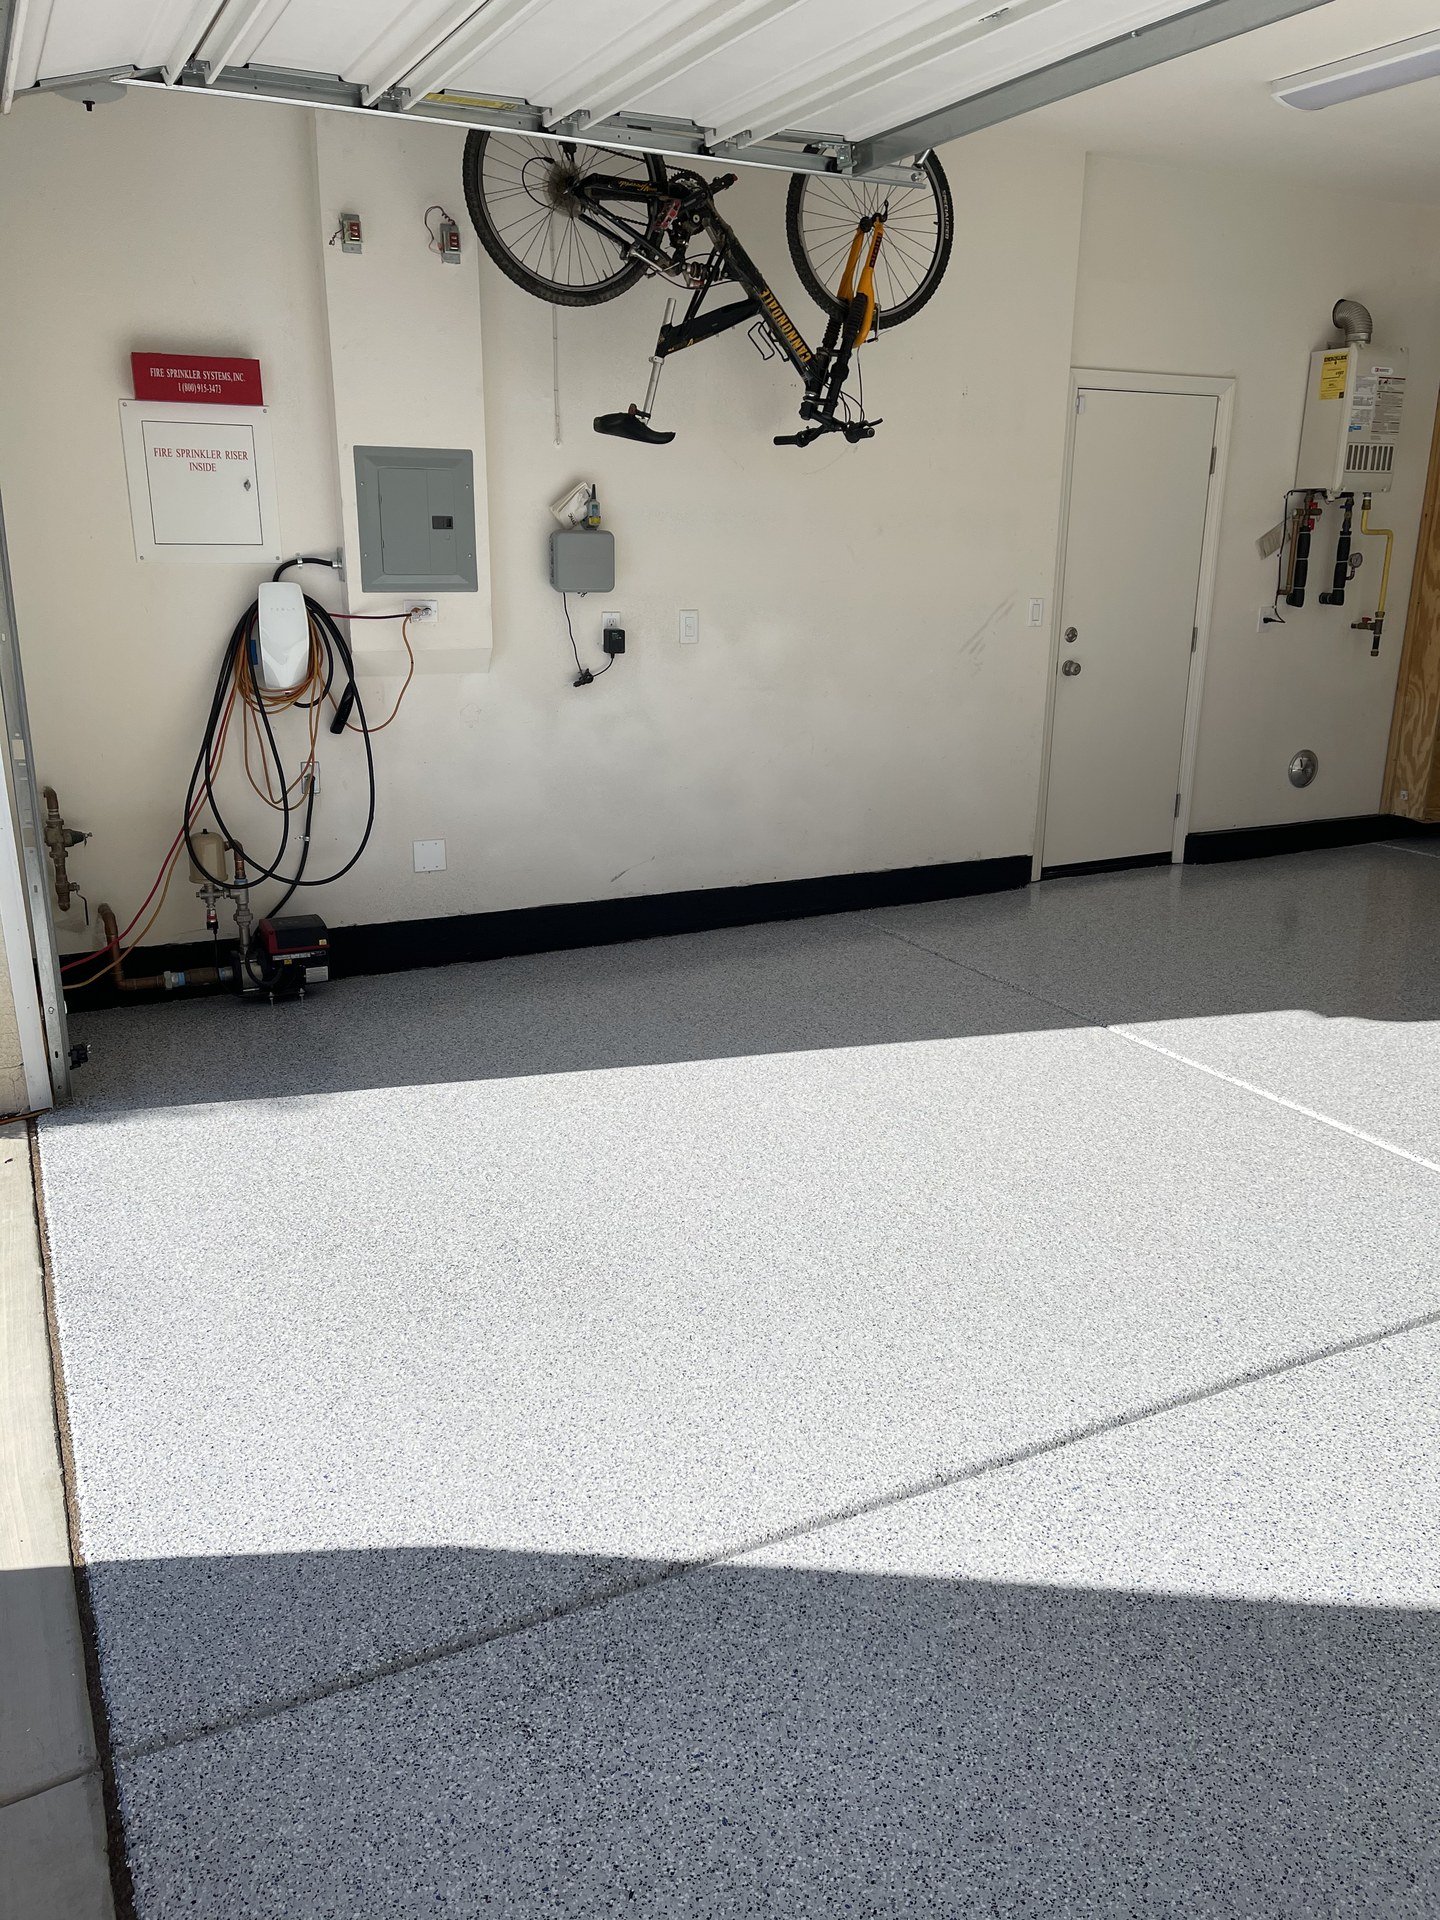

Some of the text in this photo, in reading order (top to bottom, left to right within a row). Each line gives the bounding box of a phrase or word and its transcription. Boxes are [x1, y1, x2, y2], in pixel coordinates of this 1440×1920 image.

[760, 289, 811, 362] CANNONDALE
[150, 367, 164, 378] FIRE
[166, 368, 201, 380] SPRINKLER
[154, 447, 248, 460] FIRE SPRINKLER RISER
[189, 462, 217, 472] INSIDE
